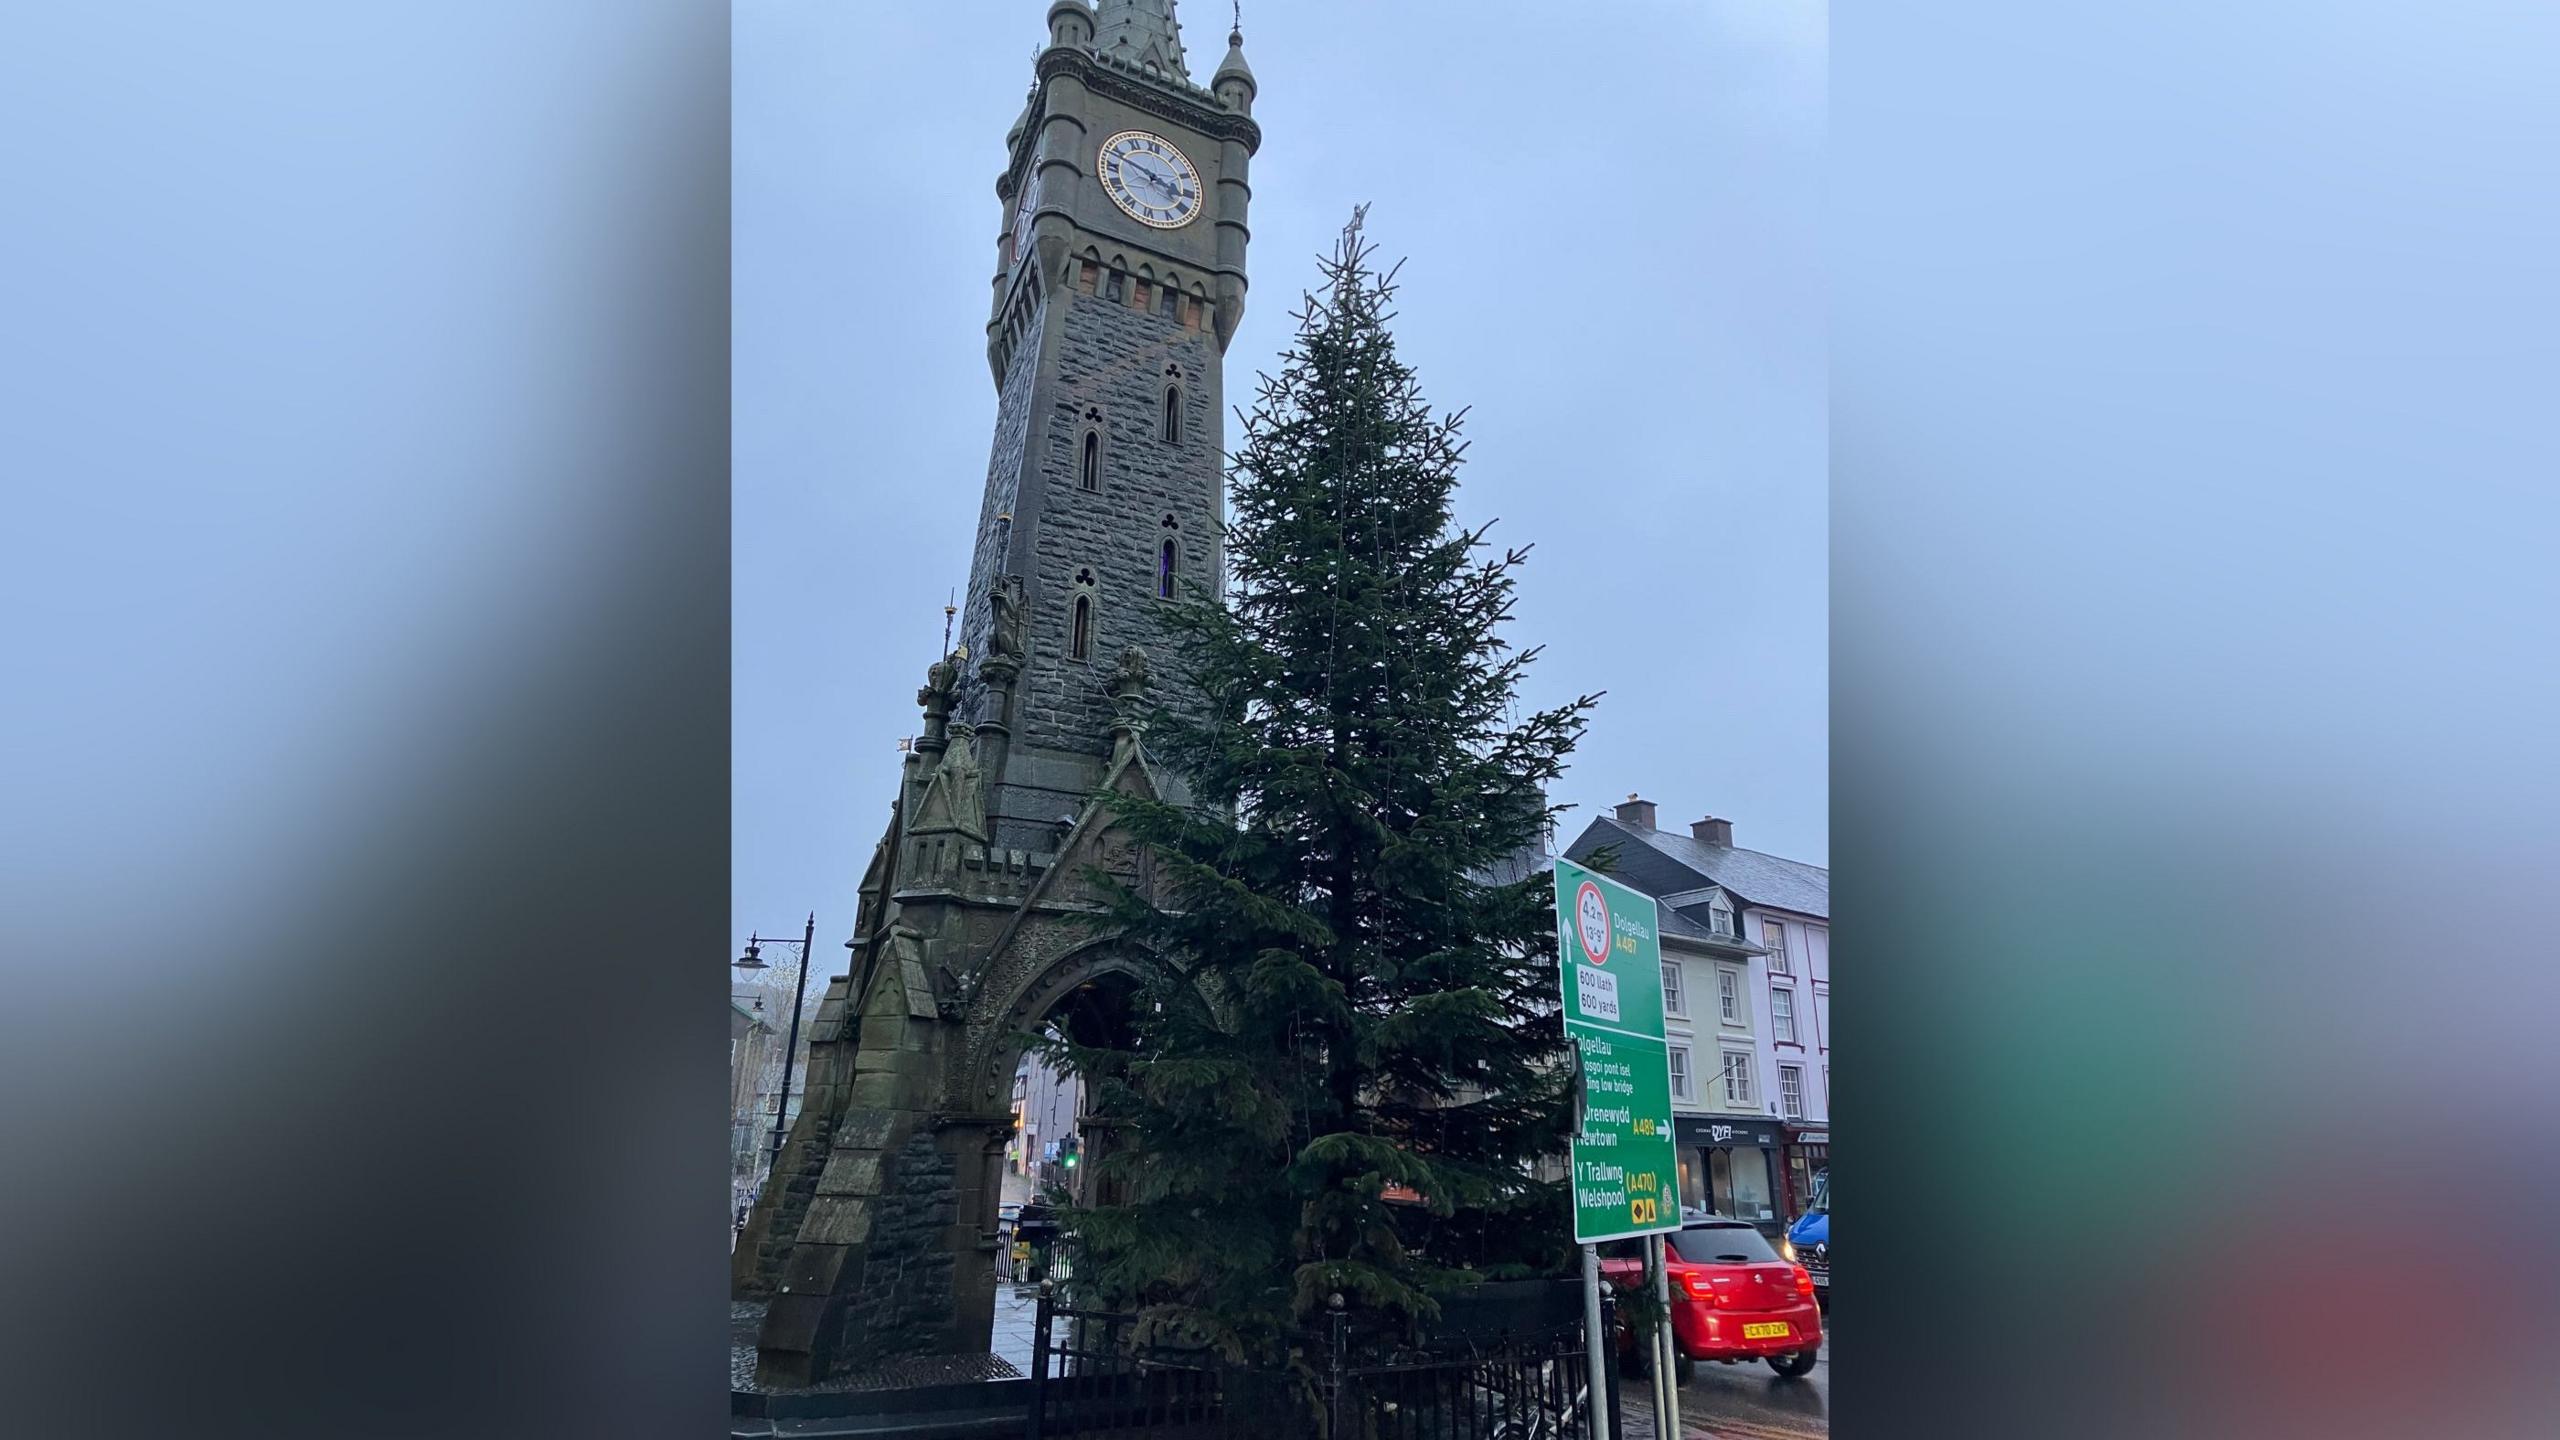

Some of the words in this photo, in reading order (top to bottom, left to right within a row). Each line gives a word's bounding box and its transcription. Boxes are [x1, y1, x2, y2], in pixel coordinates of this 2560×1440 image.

[1614, 912, 1650, 940] Dolgellau
[1616, 933, 1637, 954] A487
[1580, 970, 1596, 988] 600
[1581, 993, 1597, 1010] 600
[1599, 1000, 1617, 1015] yards
[1604, 1062, 1619, 1076] pont
[1620, 1062, 1631, 1077] isel
[1601, 1078, 1613, 1091] low
[1614, 1079, 1634, 1096] bridge
[1633, 1117, 1655, 1136] A489
[1711, 1125, 1732, 1141] DYFI
[1577, 1161, 1584, 1182] Y
[1586, 1161, 1623, 1185] Trallwng
[1626, 1171, 1657, 1195] (A470)
[1579, 1186, 1626, 1210] Welshpool
